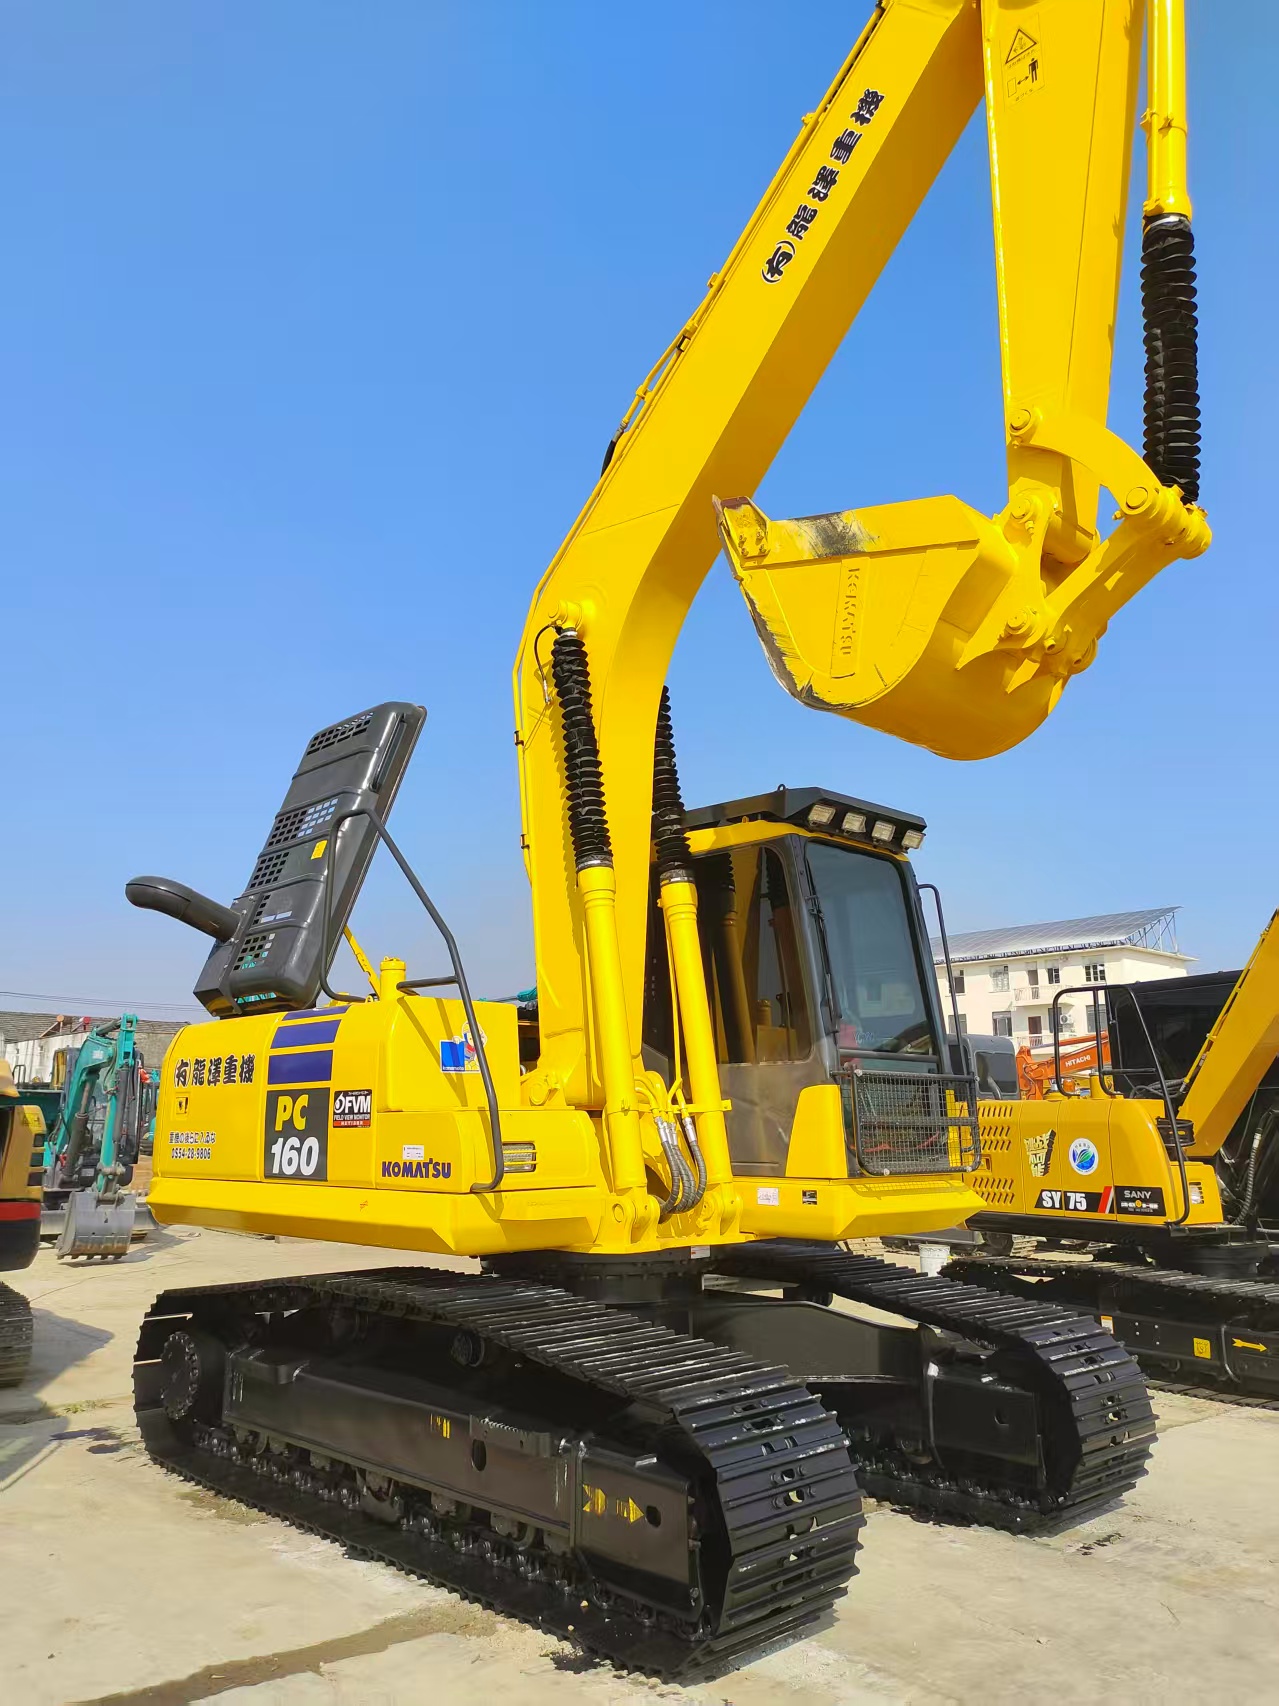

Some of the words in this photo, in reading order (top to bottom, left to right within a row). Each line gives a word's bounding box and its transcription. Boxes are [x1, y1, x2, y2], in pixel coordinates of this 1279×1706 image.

[1065, 1055, 1091, 1068] HITACHI
[275, 1094, 309, 1131] PC
[271, 1136, 320, 1176] 160
[381, 1157, 452, 1179] KOMATSU
[1041, 1190, 1062, 1208] SY
[1066, 1192, 1087, 1211] 75
[1123, 1190, 1152, 1199] SANY
